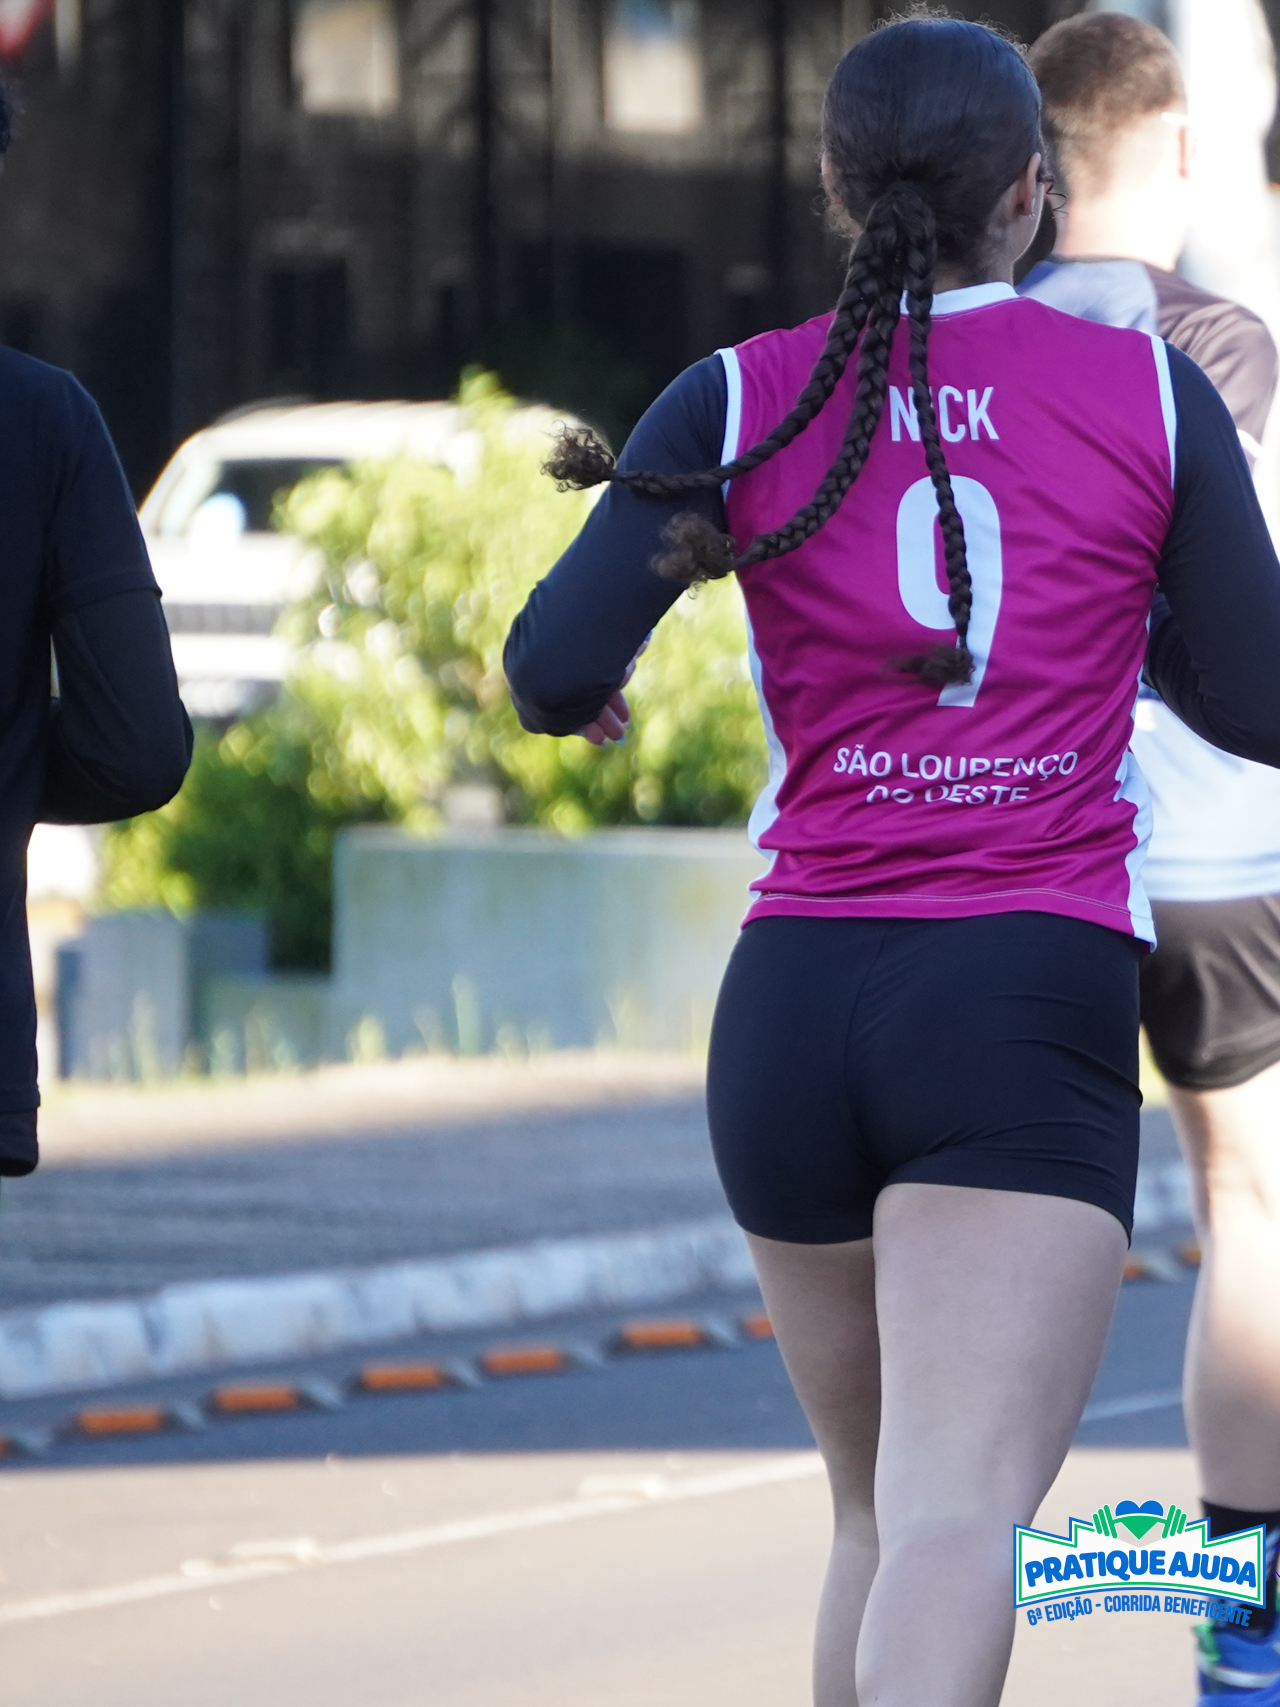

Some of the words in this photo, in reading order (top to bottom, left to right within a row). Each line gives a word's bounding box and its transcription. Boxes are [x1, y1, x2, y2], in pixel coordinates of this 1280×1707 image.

[889, 385, 999, 442] NCK
[896, 474, 1003, 707] 9
[833, 744, 891, 777] SÃO
